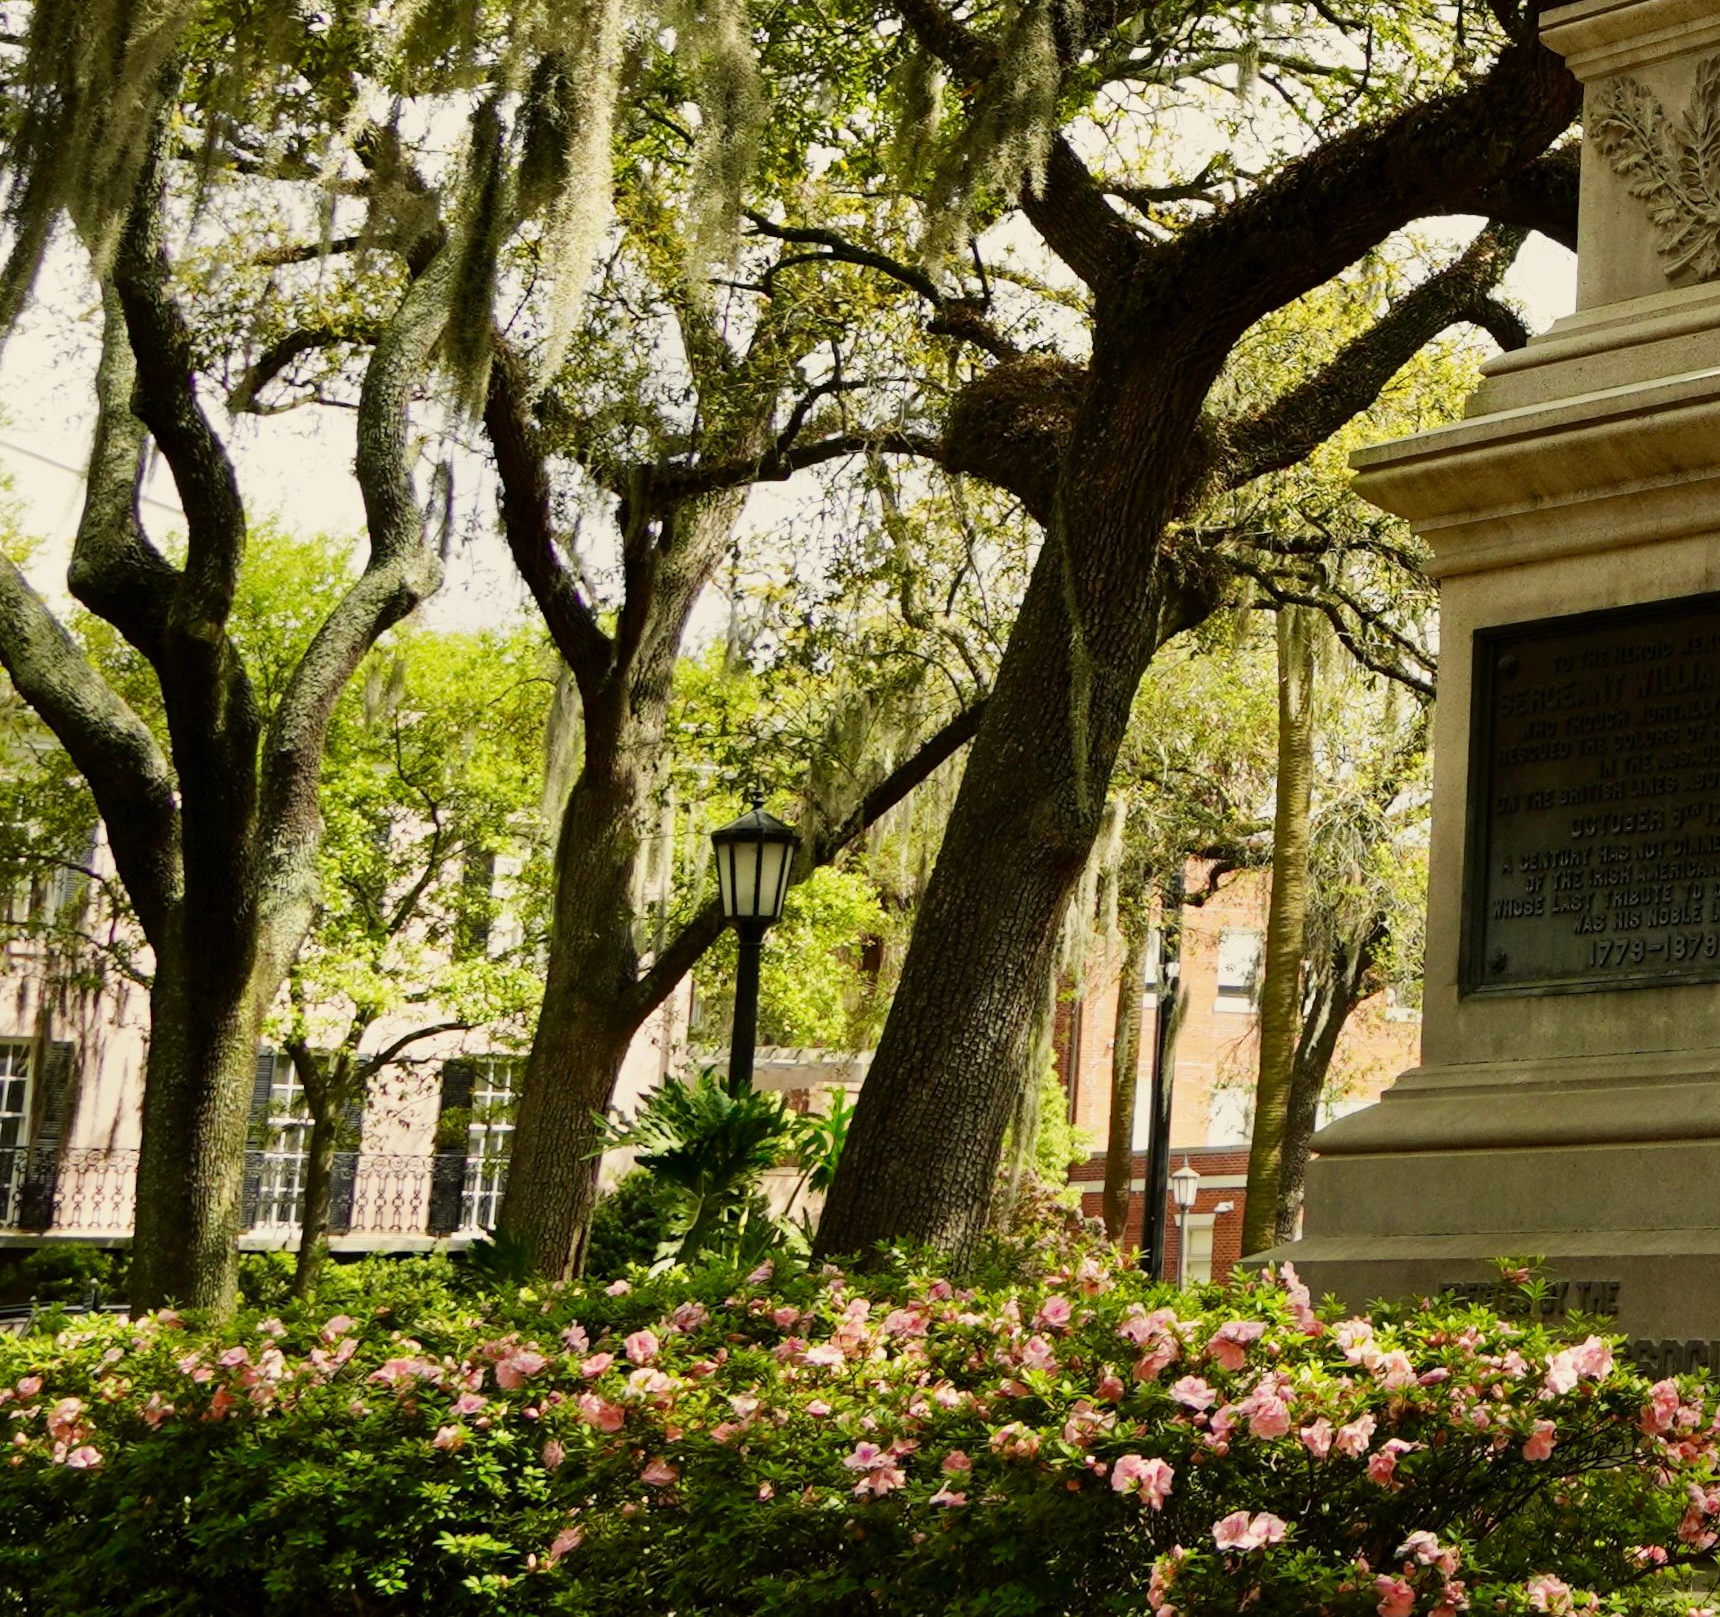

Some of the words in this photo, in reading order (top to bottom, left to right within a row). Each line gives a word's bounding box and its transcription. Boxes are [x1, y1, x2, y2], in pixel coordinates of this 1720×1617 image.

[1552, 655, 1574, 674] TO
[1579, 647, 1607, 669] THE
[1615, 639, 1673, 665] HEROIC
[1500, 674, 1626, 718] SERGEANT
[1521, 717, 1558, 740] WHO
[1565, 707, 1629, 735] THOUGH
[1498, 741, 1569, 766] RESCUED
[1578, 734, 1607, 755] THE
[1614, 726, 1679, 751] COLORS
[1686, 721, 1709, 742] OF
[1599, 757, 1618, 778] IN
[1622, 753, 1653, 775] THE
[1496, 793, 1519, 815] ON
[1524, 787, 1555, 812] THE
[1558, 780, 1625, 806] BRITISH
[1630, 773, 1679, 798] LINES
[1568, 807, 1665, 840] OCTOBER
[1501, 854, 1513, 875] A
[1519, 845, 1593, 873] CENTURY
[1597, 842, 1632, 864] HAS
[1636, 838, 1669, 860] NOT
[1524, 873, 1546, 895] OF
[1552, 868, 1585, 891] THE
[1588, 863, 1632, 887] IRISH
[1492, 895, 1545, 920] WHOSE
[1551, 889, 1595, 914] LAST
[1603, 882, 1675, 910] TRIBUTE
[1683, 879, 1704, 902] TO
[1573, 912, 1607, 935] WAS
[1613, 908, 1640, 931] HIS
[1646, 903, 1703, 928] NOBLE
